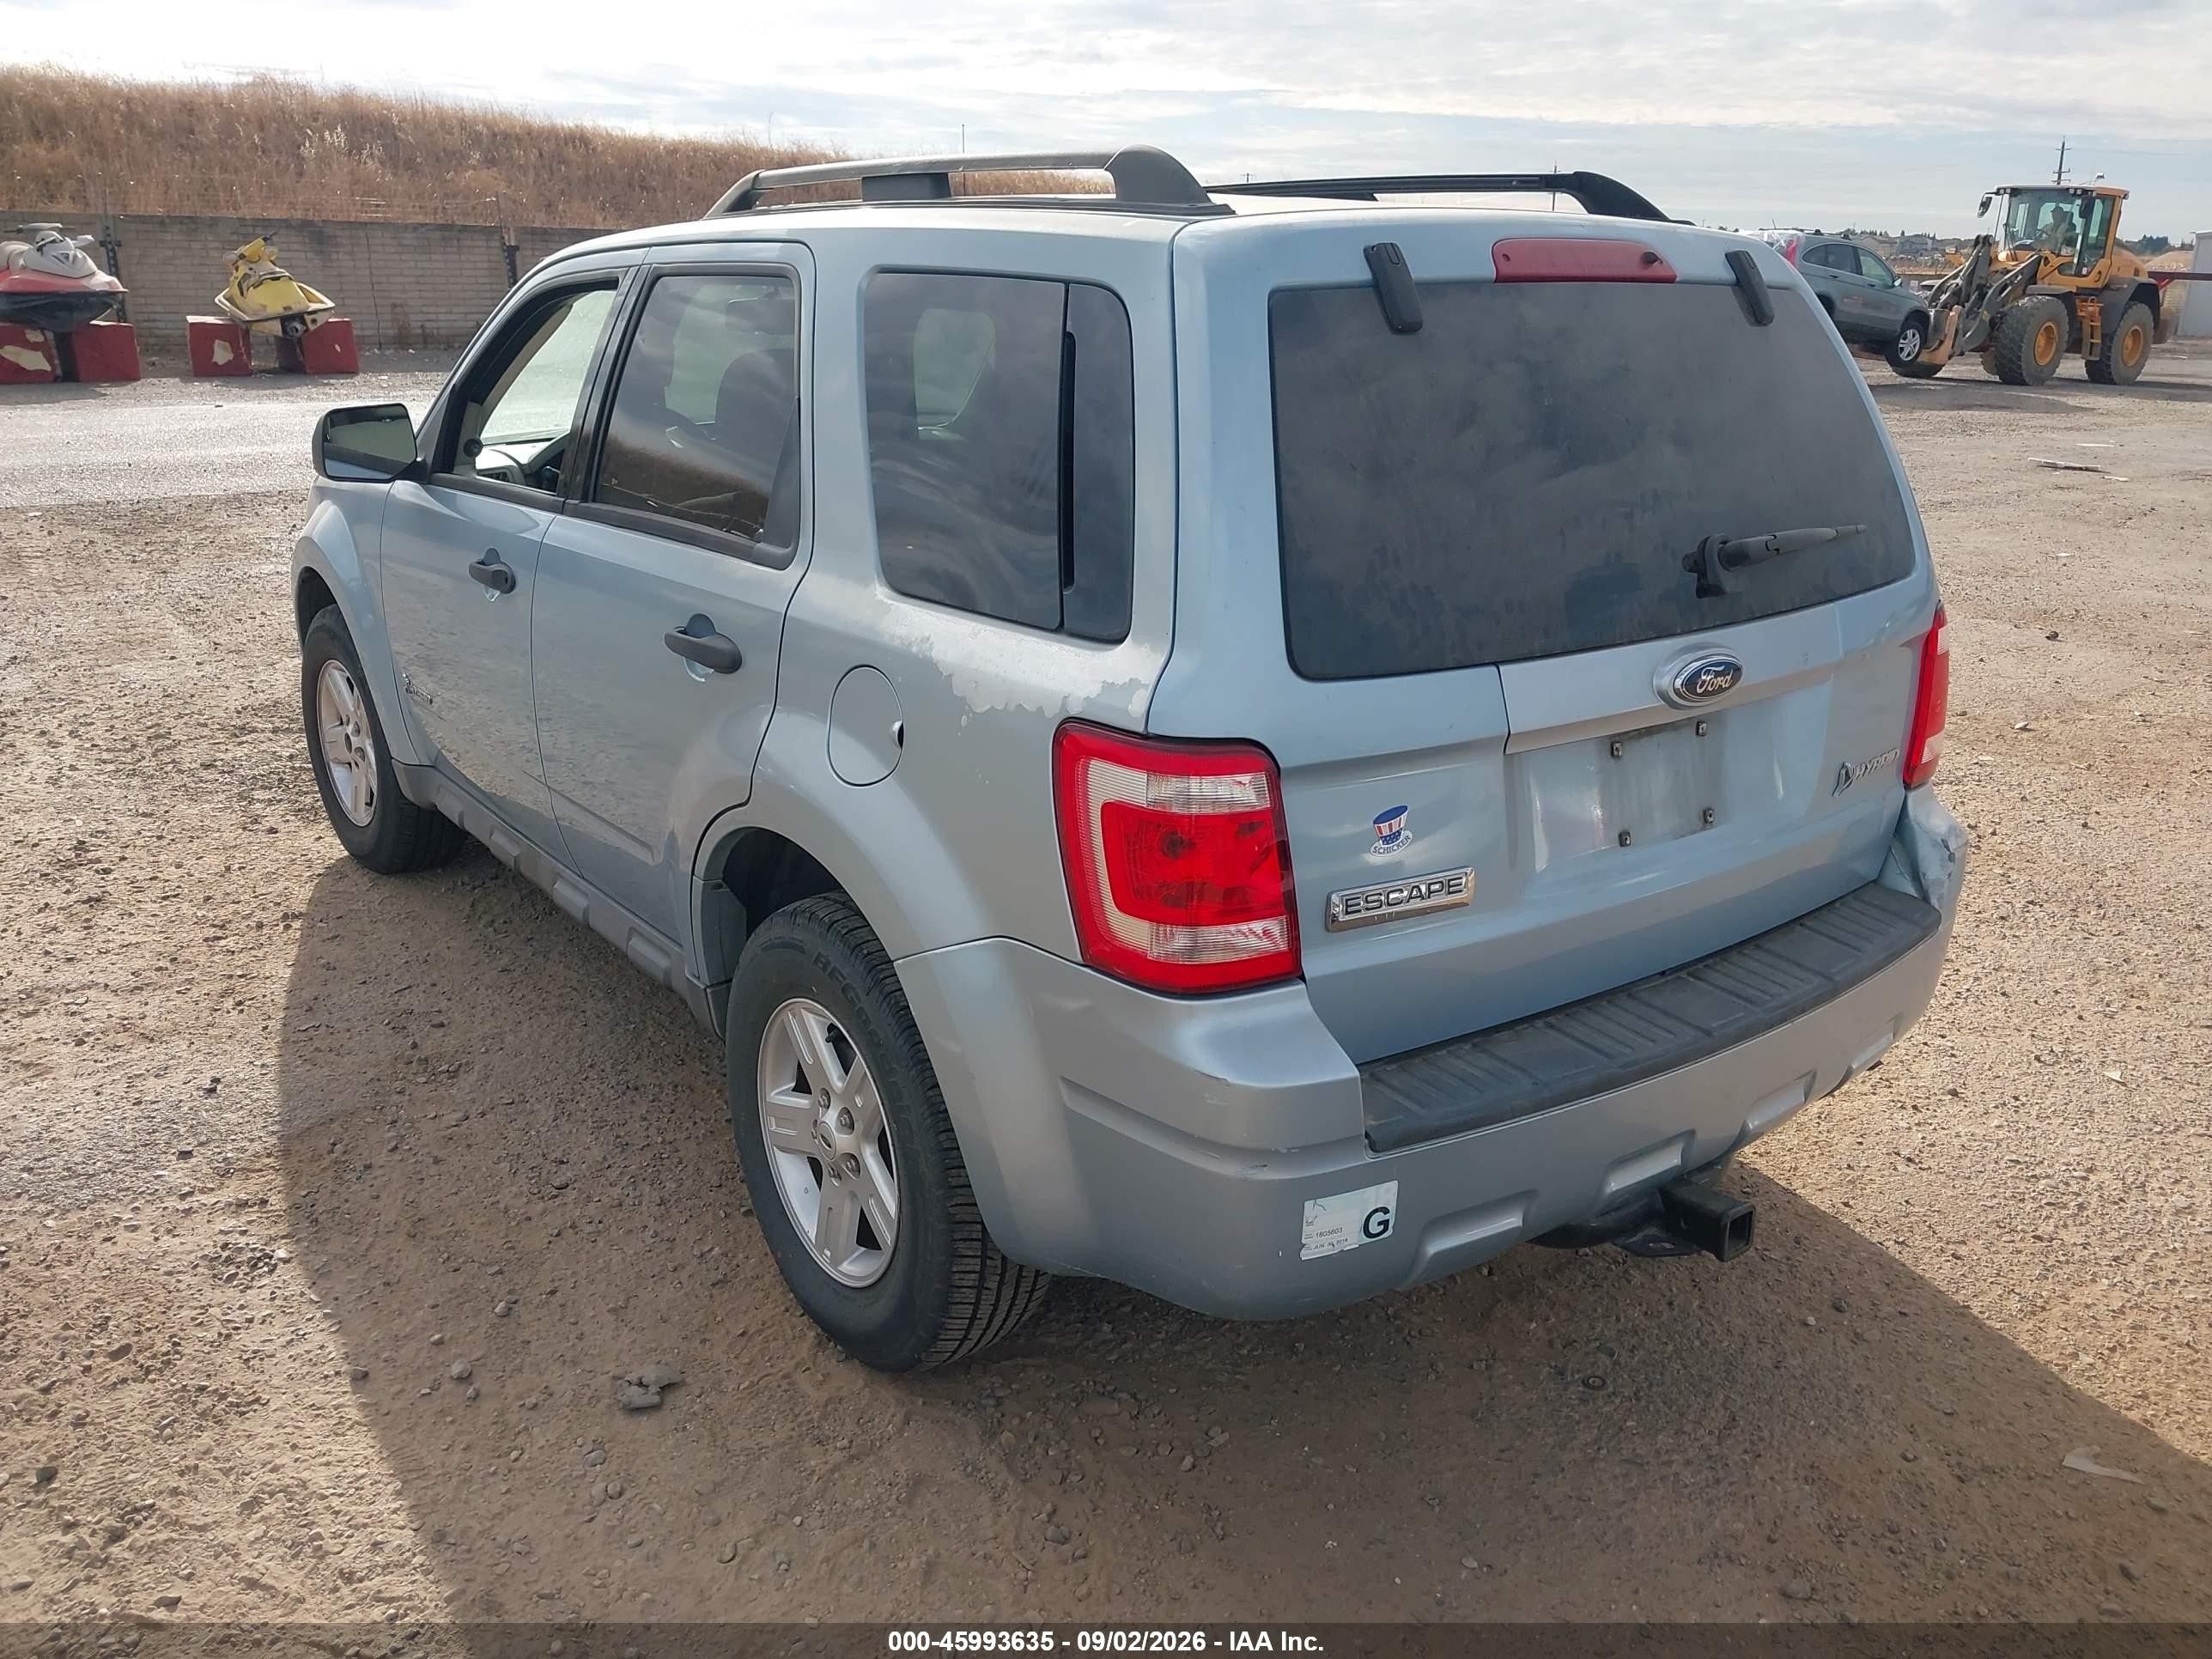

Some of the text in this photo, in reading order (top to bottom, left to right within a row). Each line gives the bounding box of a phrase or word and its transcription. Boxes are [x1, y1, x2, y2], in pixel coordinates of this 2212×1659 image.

[1695, 664, 1734, 694] Ford
[1371, 835, 1411, 854] SCHICKER
[1345, 877, 1464, 915] ESCAPE
[1363, 1206, 1390, 1239] G
